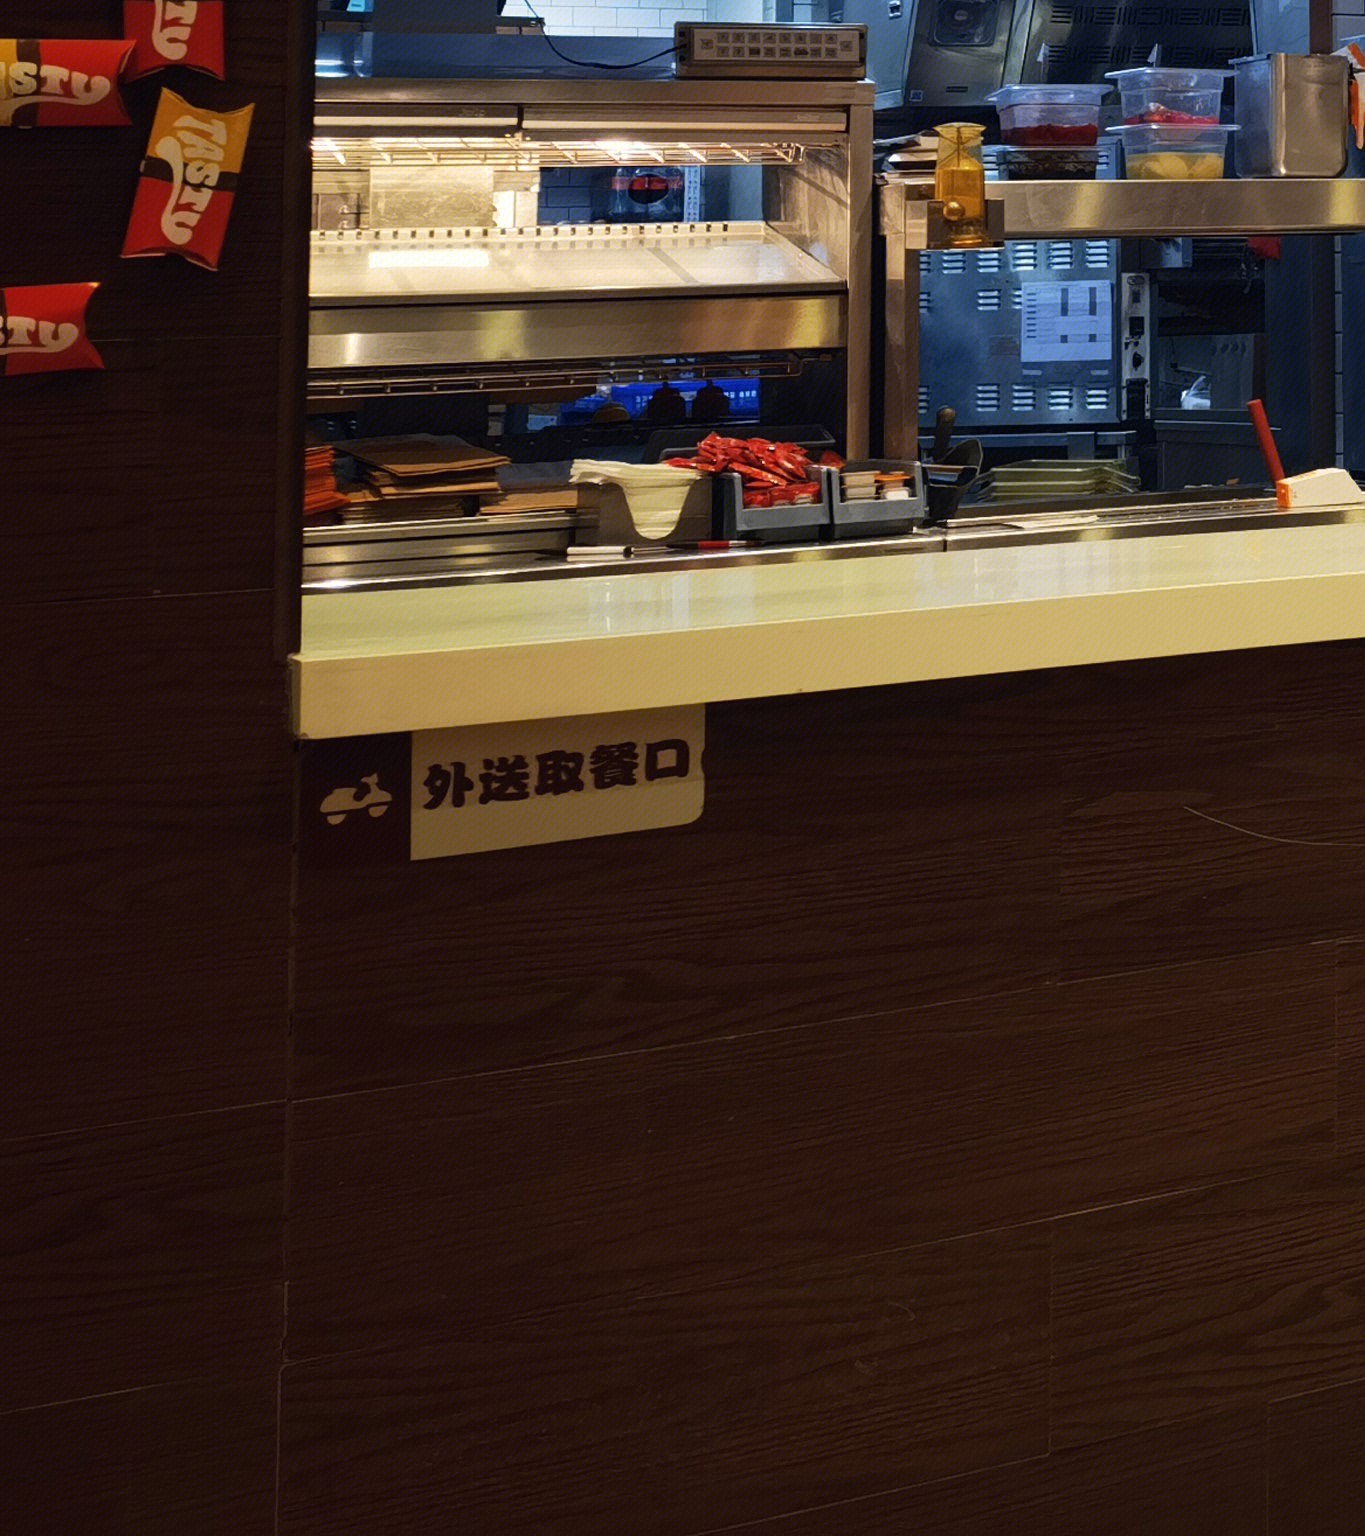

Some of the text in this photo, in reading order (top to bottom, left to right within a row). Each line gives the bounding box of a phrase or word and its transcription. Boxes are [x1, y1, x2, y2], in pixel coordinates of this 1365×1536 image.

[422, 737, 692, 812] 外送取餐口
